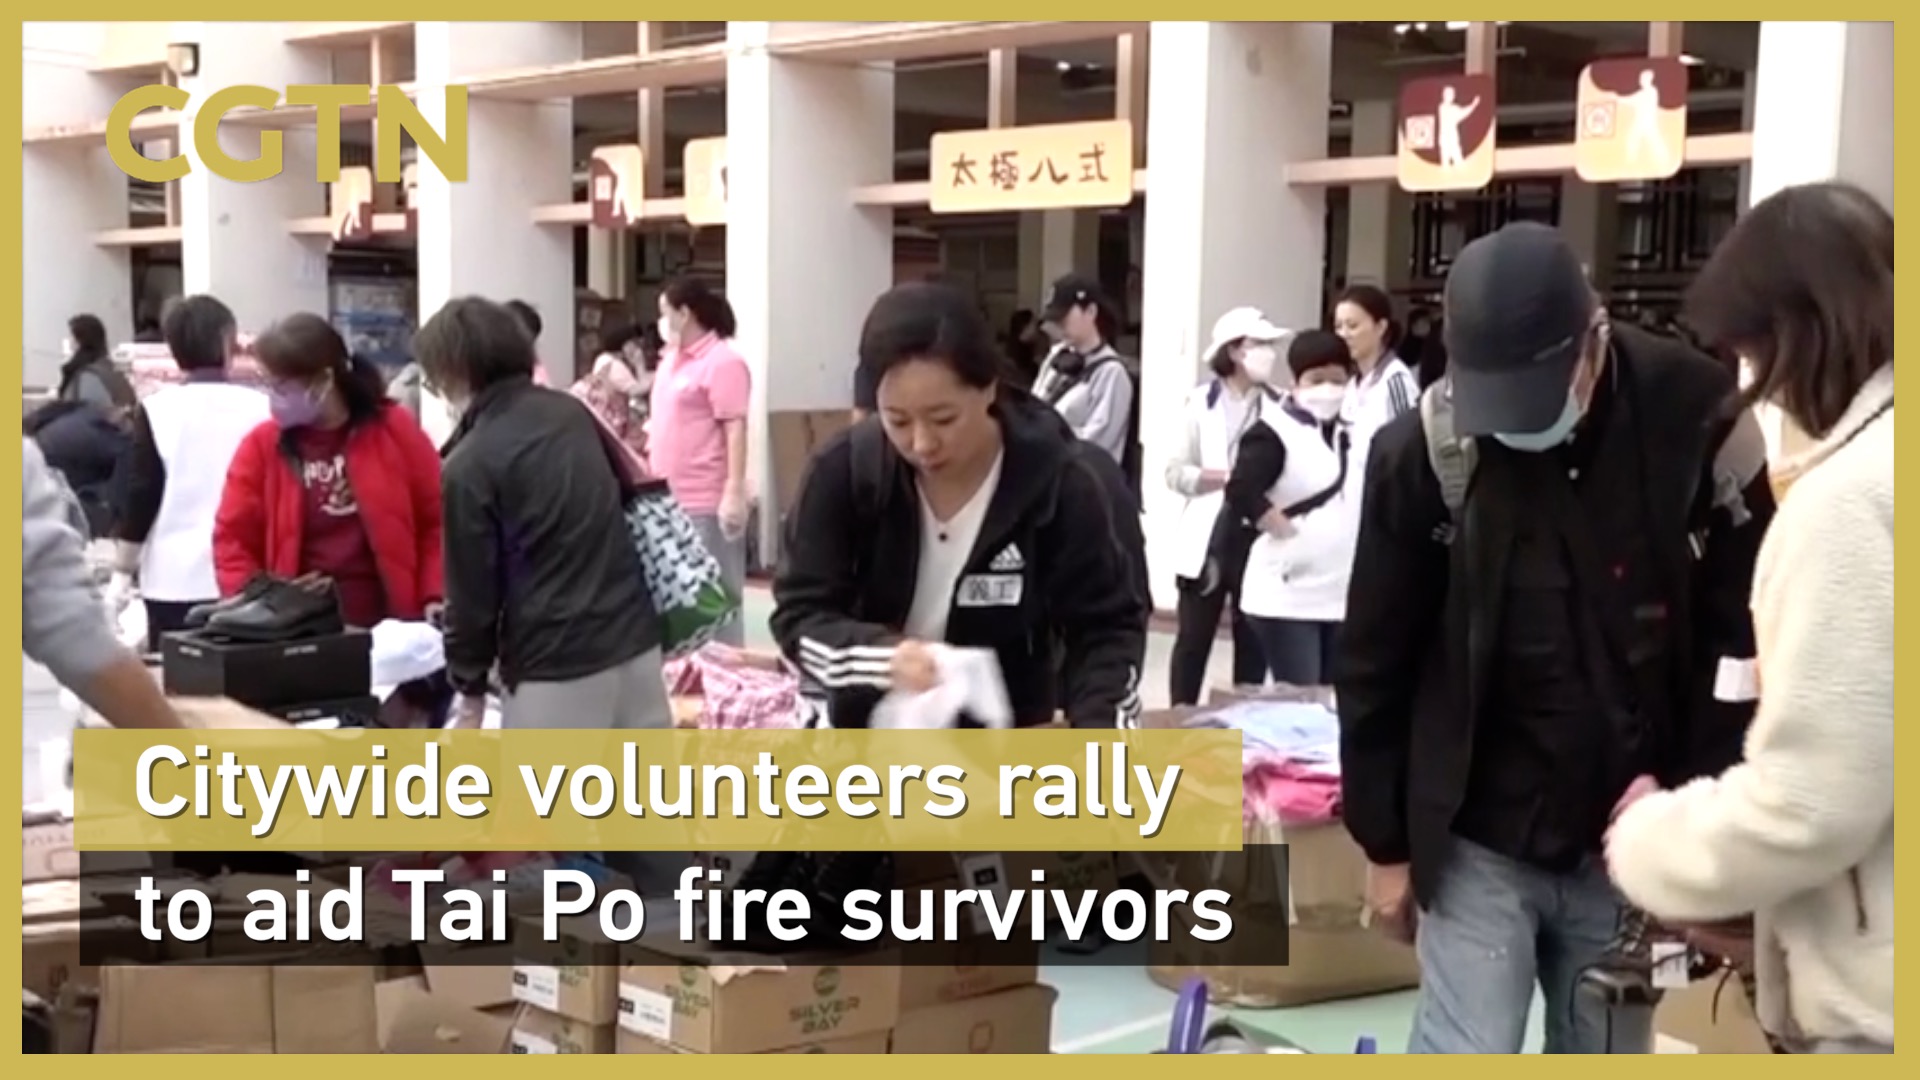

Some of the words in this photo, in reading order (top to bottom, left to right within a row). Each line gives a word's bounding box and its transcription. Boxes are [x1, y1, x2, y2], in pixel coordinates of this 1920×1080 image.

[951, 142, 1109, 190] 太極八式
[789, 996, 860, 1021] SILVER
[801, 1014, 842, 1034] BAY
